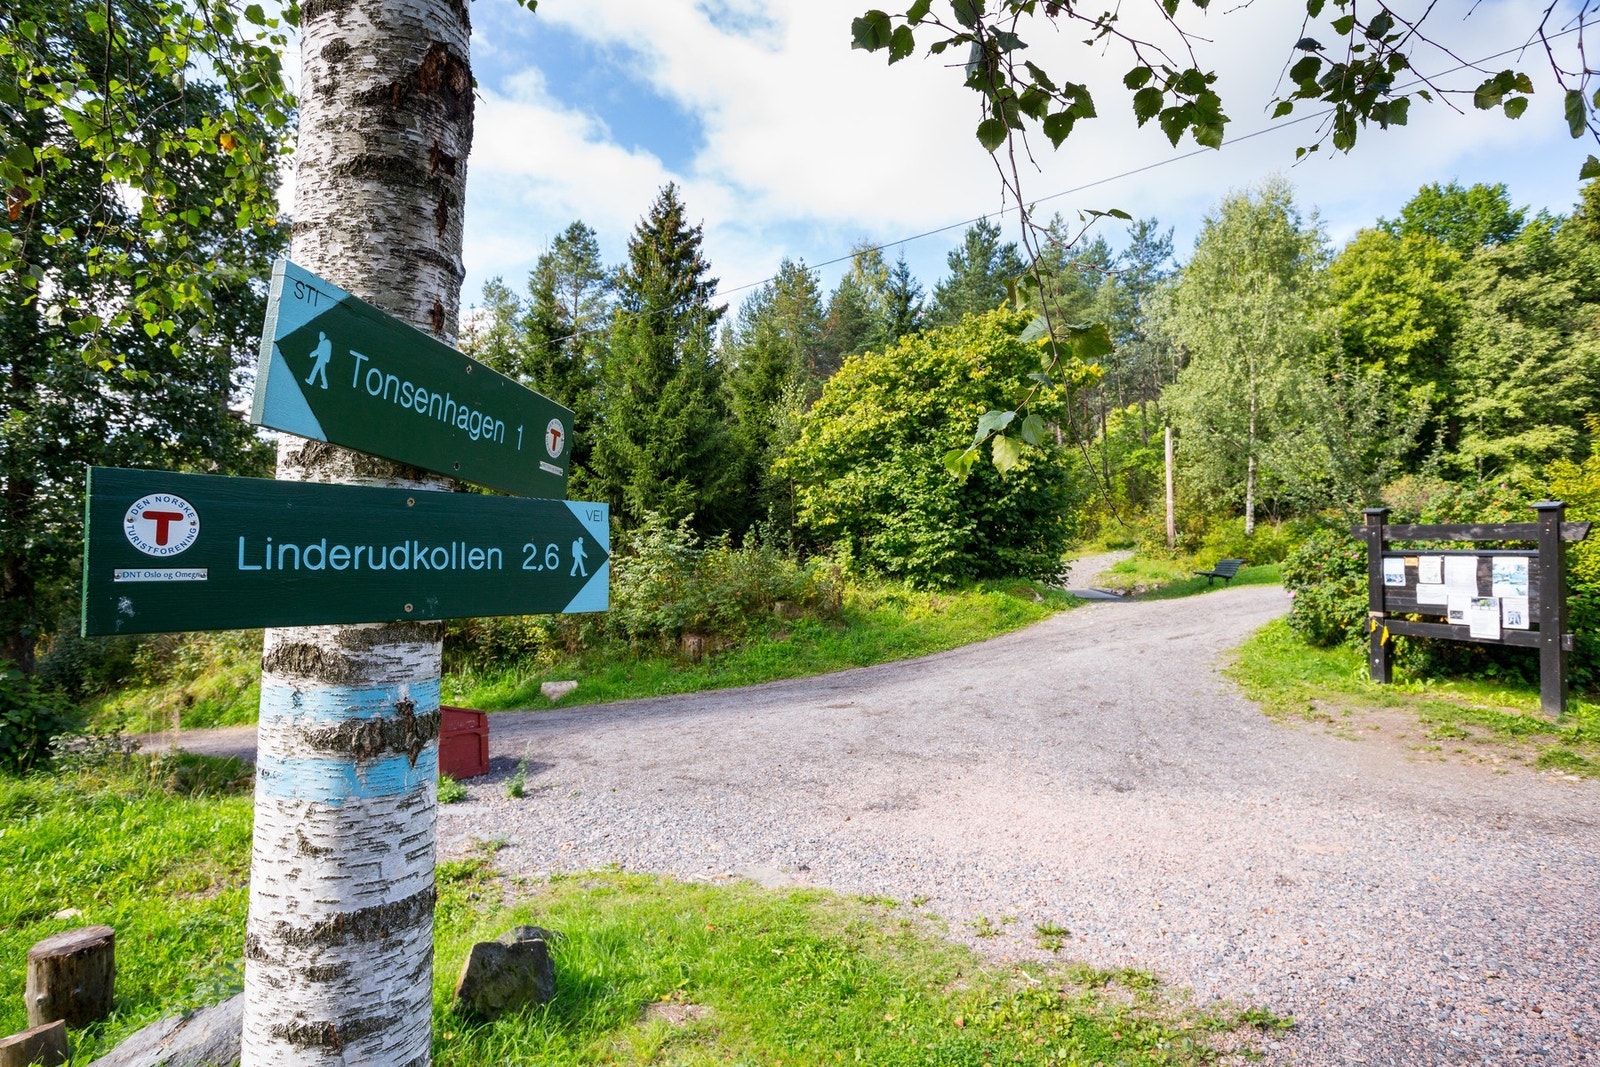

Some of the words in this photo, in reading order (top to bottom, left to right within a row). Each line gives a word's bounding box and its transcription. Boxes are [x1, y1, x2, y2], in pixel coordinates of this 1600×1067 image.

[293, 280, 319, 307] STI
[349, 349, 505, 443] Tonsenhagen
[517, 424, 524, 451] 1
[130, 498, 151, 516] DEN
[155, 496, 196, 519] NORSKE
[585, 509, 603, 522] VEI
[127, 524, 197, 555] TURISTFORENING
[142, 510, 184, 547] T
[238, 536, 503, 571] Linderudkollen
[522, 543, 560, 572] 2,6
[175, 571, 201, 579] Omegn
